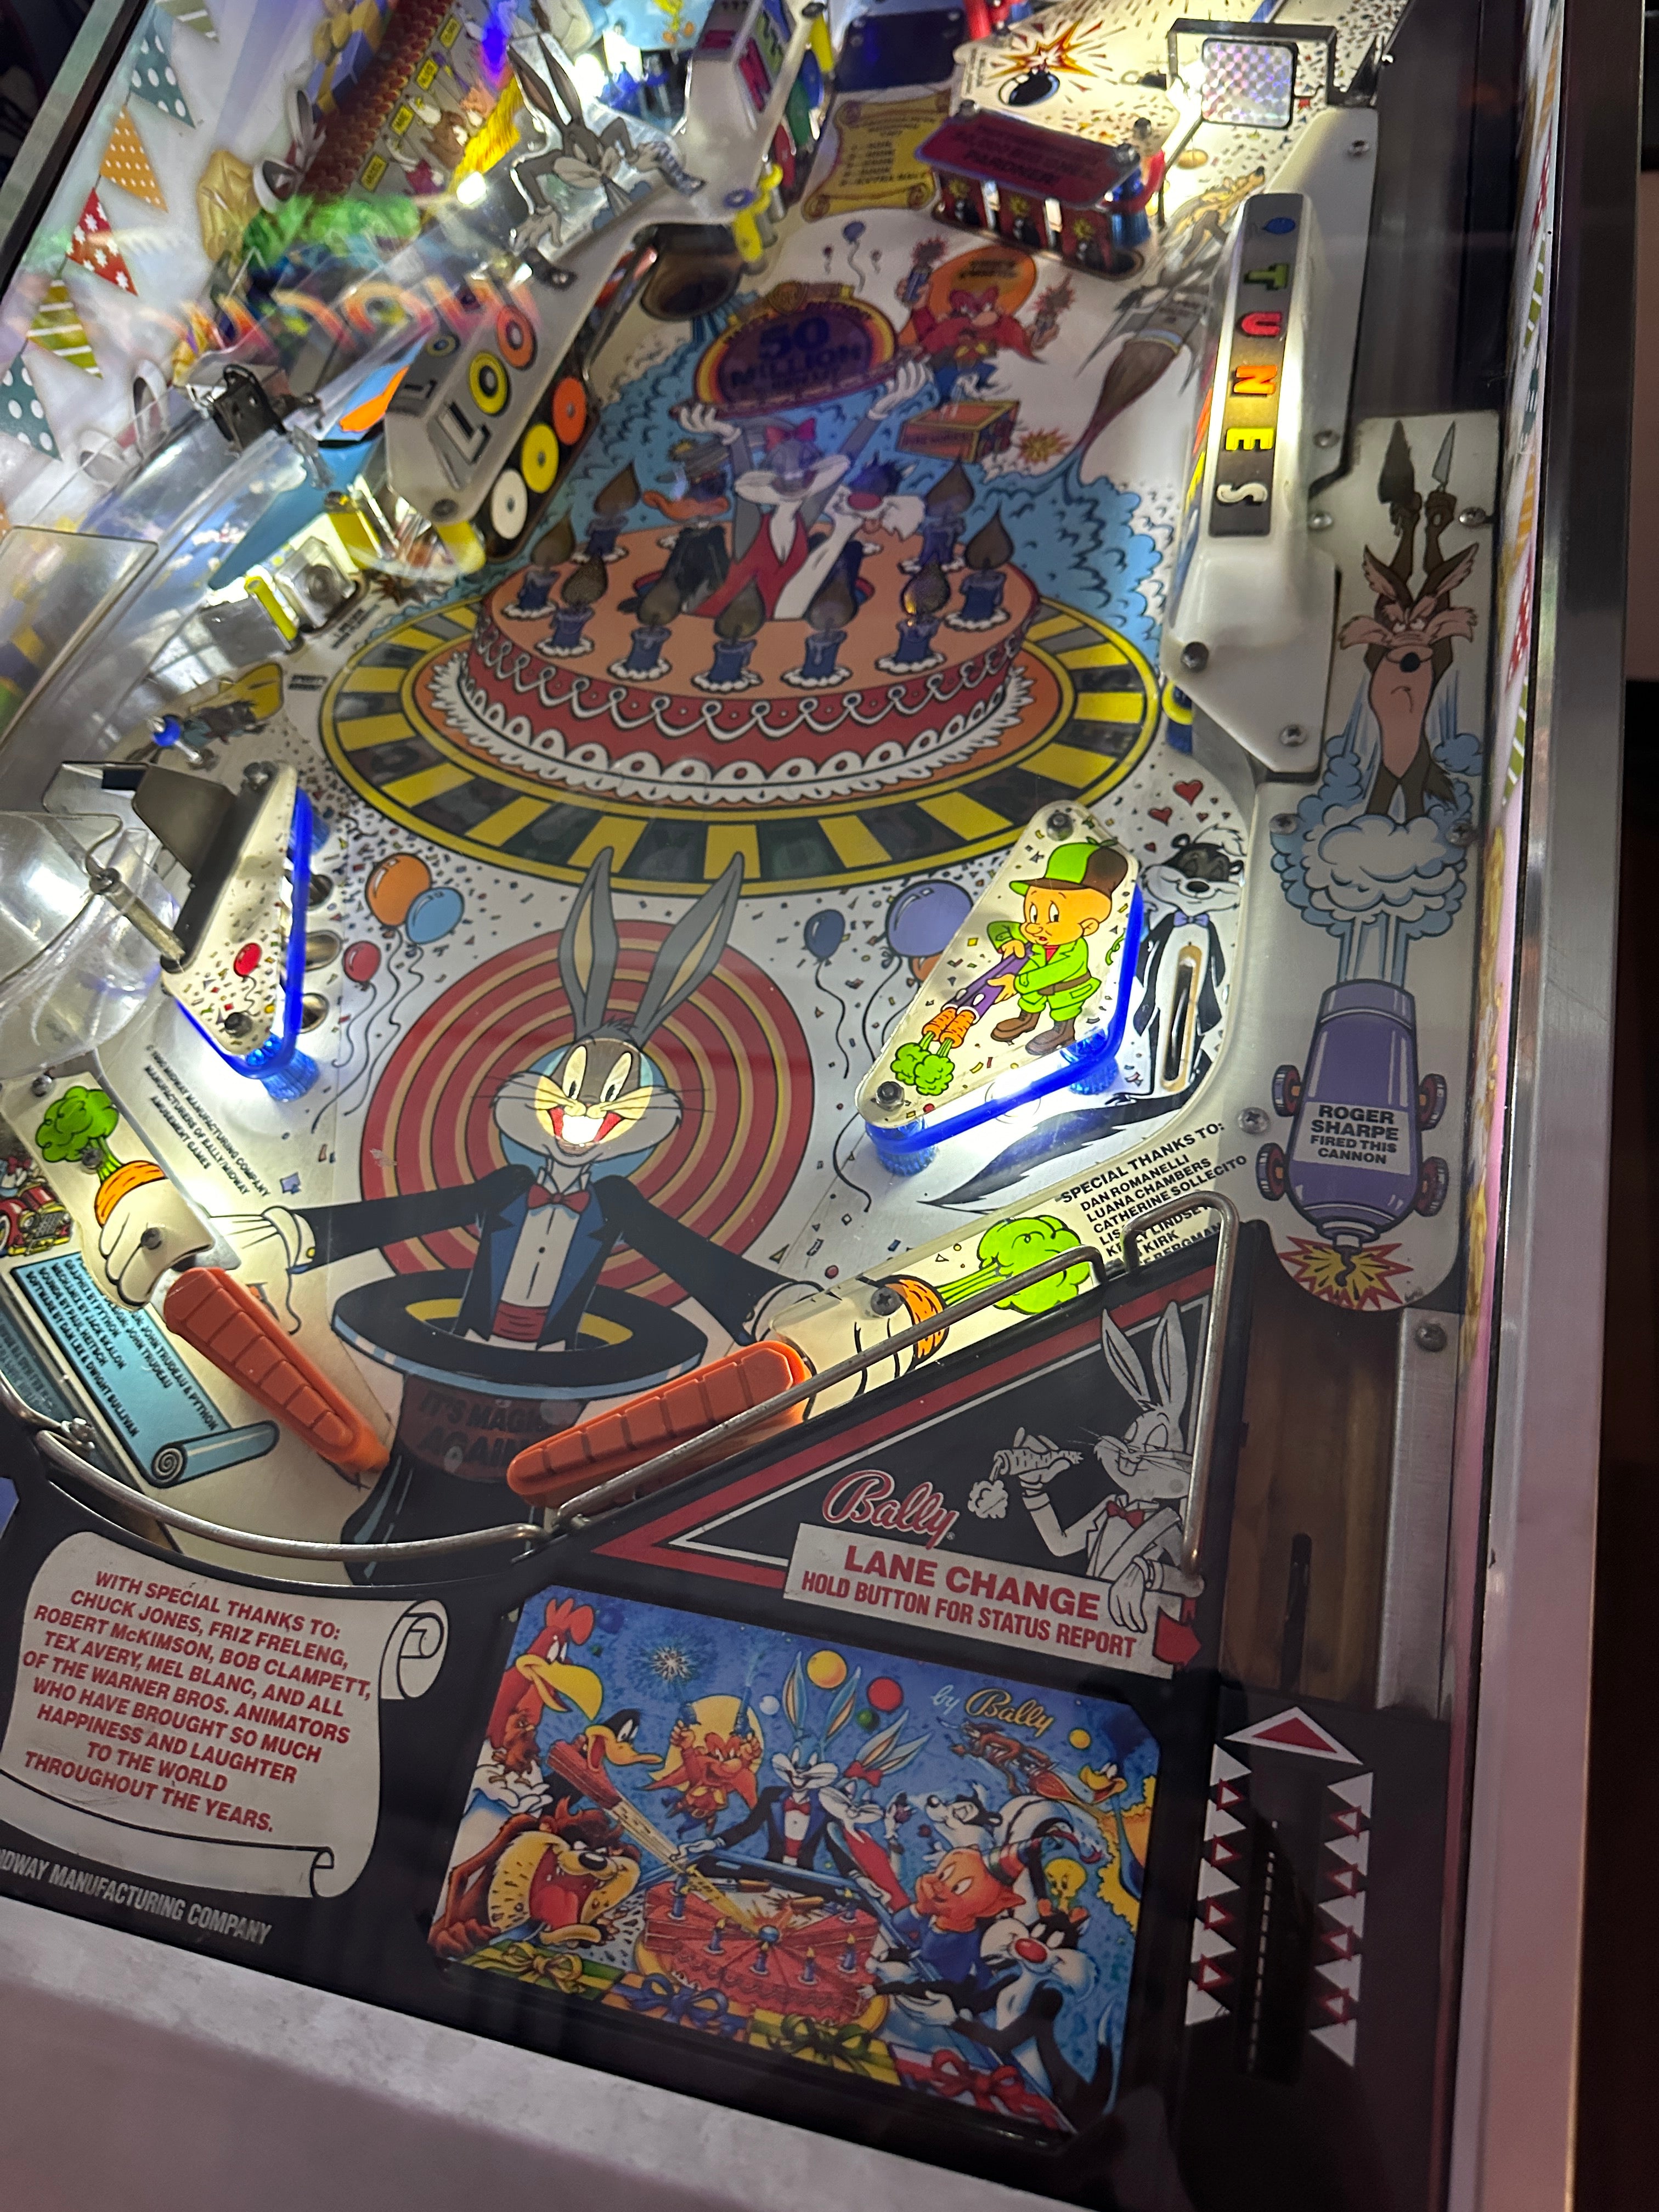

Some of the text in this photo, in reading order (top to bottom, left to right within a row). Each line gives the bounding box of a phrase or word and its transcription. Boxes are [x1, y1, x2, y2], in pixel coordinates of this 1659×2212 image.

[759, 317, 830, 360] 50
[145, 1065, 251, 1195] MANUFACTURERS OF BALLY/MIDWAY
[150, 1095, 212, 1170] AMUSEMENT GAMES
[163, 1065, 189, 1095] MIDWAY
[185, 1093, 239, 1159] MANUFACTURING
[235, 1157, 271, 1197] COMPANY
[1310, 1135, 1397, 1153] FIRED THIS
[1311, 1120, 1398, 1141] SHARPE
[1318, 1105, 1394, 1124] ROGER
[1061, 1123, 1224, 1203] SPECIAL THANKS TO:
[1080, 1154, 1190, 1211] DAN ROMANELLI
[1086, 1158, 1211, 1223] LUANA CHAMBERS
[1318, 1148, 1386, 1164] CANNON
[1093, 1155, 1247, 1233] CATHERINE SOLLECITO
[1142, 1229, 1180, 1254] KIRK
[59, 1297, 72, 1310] BY
[65, 1308, 84, 1332] PAUL
[77, 1301, 91, 1315] BY
[86, 1315, 105, 1336] JACK
[99, 1334, 127, 1369] SKALON
[87, 1292, 99, 1305] BY
[94, 1302, 122, 1338] PYTHON
[26, 1271, 57, 1313] SOFTWARE
[53, 1311, 65, 1323] BY
[59, 1322, 77, 1341] DAN
[71, 1339, 86, 1356] LEE
[86, 1361, 112, 1395] DWIGHT
[108, 1393, 140, 1437] SULLIVAN
[80, 1328, 109, 1367] HEITSCH
[126, 1327, 145, 1351] JOHN
[142, 1347, 173, 1388] TRUDEAU
[141, 1325, 161, 1349] JOHN
[157, 1346, 189, 1387] TRUDEAU
[188, 1392, 219, 1431] PYTHON
[822, 1469, 960, 1550] Bally
[95, 1571, 341, 1640] WITH SPECIAL THANKS TO:
[802, 1571, 1137, 1658] HOLD BUTTON FOR STATUS REPORT
[844, 1545, 1101, 1621] LANE CHANGE
[34, 1605, 371, 1701] ROBERT McKIMSON, BOB CLAMPETT,
[71, 1590, 349, 1671] CHUCK JONES, FRIZ FRELENG,
[23, 1650, 351, 1743] OF THE WARNER BROS. ANIMATORS
[44, 1630, 344, 1717] TEX AVERY, MEL BLANC, AND ALL
[33, 1677, 322, 1763] WHO HAVE BROUGHT SO MUCH
[37, 1703, 298, 1784] HAPPINESS AND LAUGHTER
[930, 1685, 1054, 1738] by Bally
[25, 1751, 273, 1832] THROUGHOUT THE YEARS.
[87, 1741, 228, 1792] TO THE WORLD
[0, 1848, 273, 1945] IDWAY MANUFACTURING COMPANY
